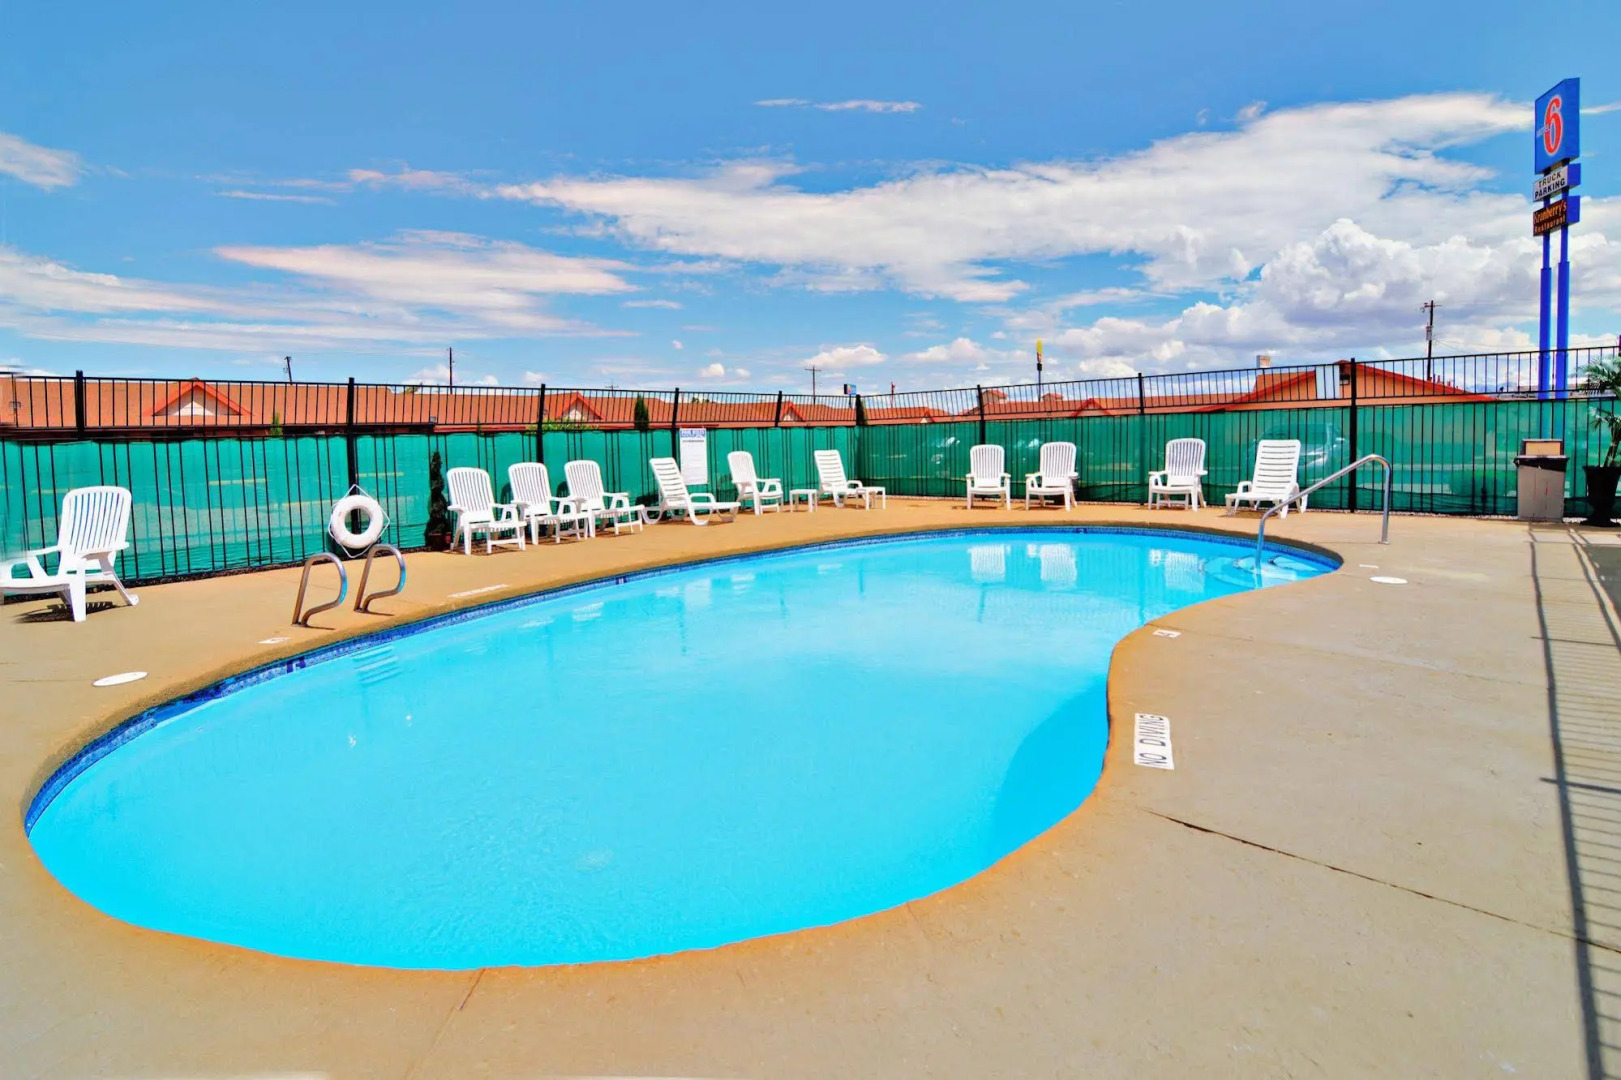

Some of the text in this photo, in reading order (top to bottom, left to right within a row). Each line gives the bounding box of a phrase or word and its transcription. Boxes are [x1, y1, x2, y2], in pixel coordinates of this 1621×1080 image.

[1543, 94, 1563, 157] 6
[1535, 178, 1566, 199] PARKING
[1538, 171, 1561, 188] TRUCK
[1138, 714, 1168, 767] NO DIVING
